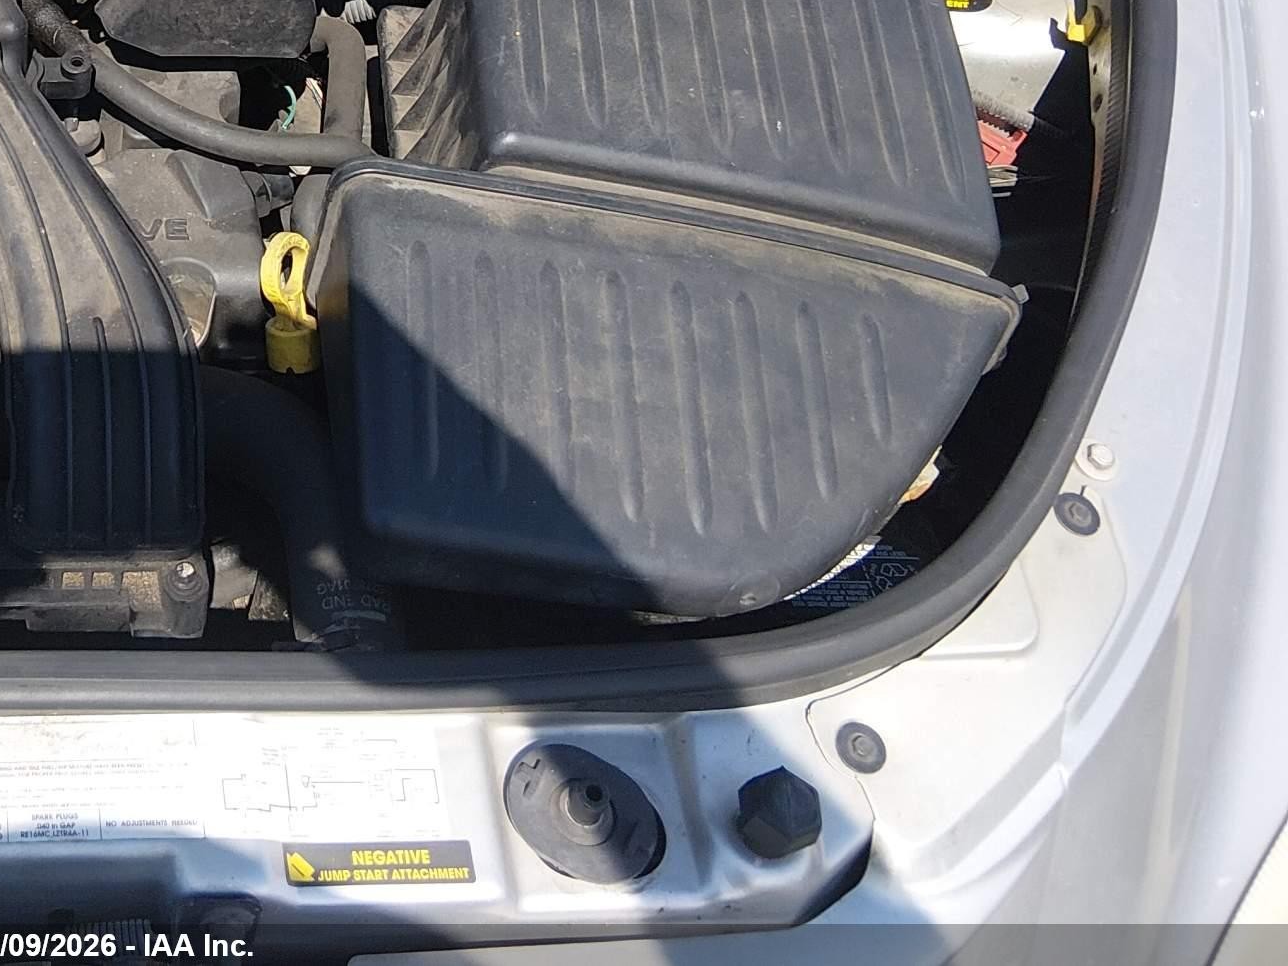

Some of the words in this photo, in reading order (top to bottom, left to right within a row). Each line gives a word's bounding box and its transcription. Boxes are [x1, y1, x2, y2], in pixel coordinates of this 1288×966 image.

[351, 850, 430, 865] NEGATIVE
[318, 870, 352, 882] JUMP
[353, 868, 390, 881] START
[392, 868, 470, 880] ATTACHMENT
